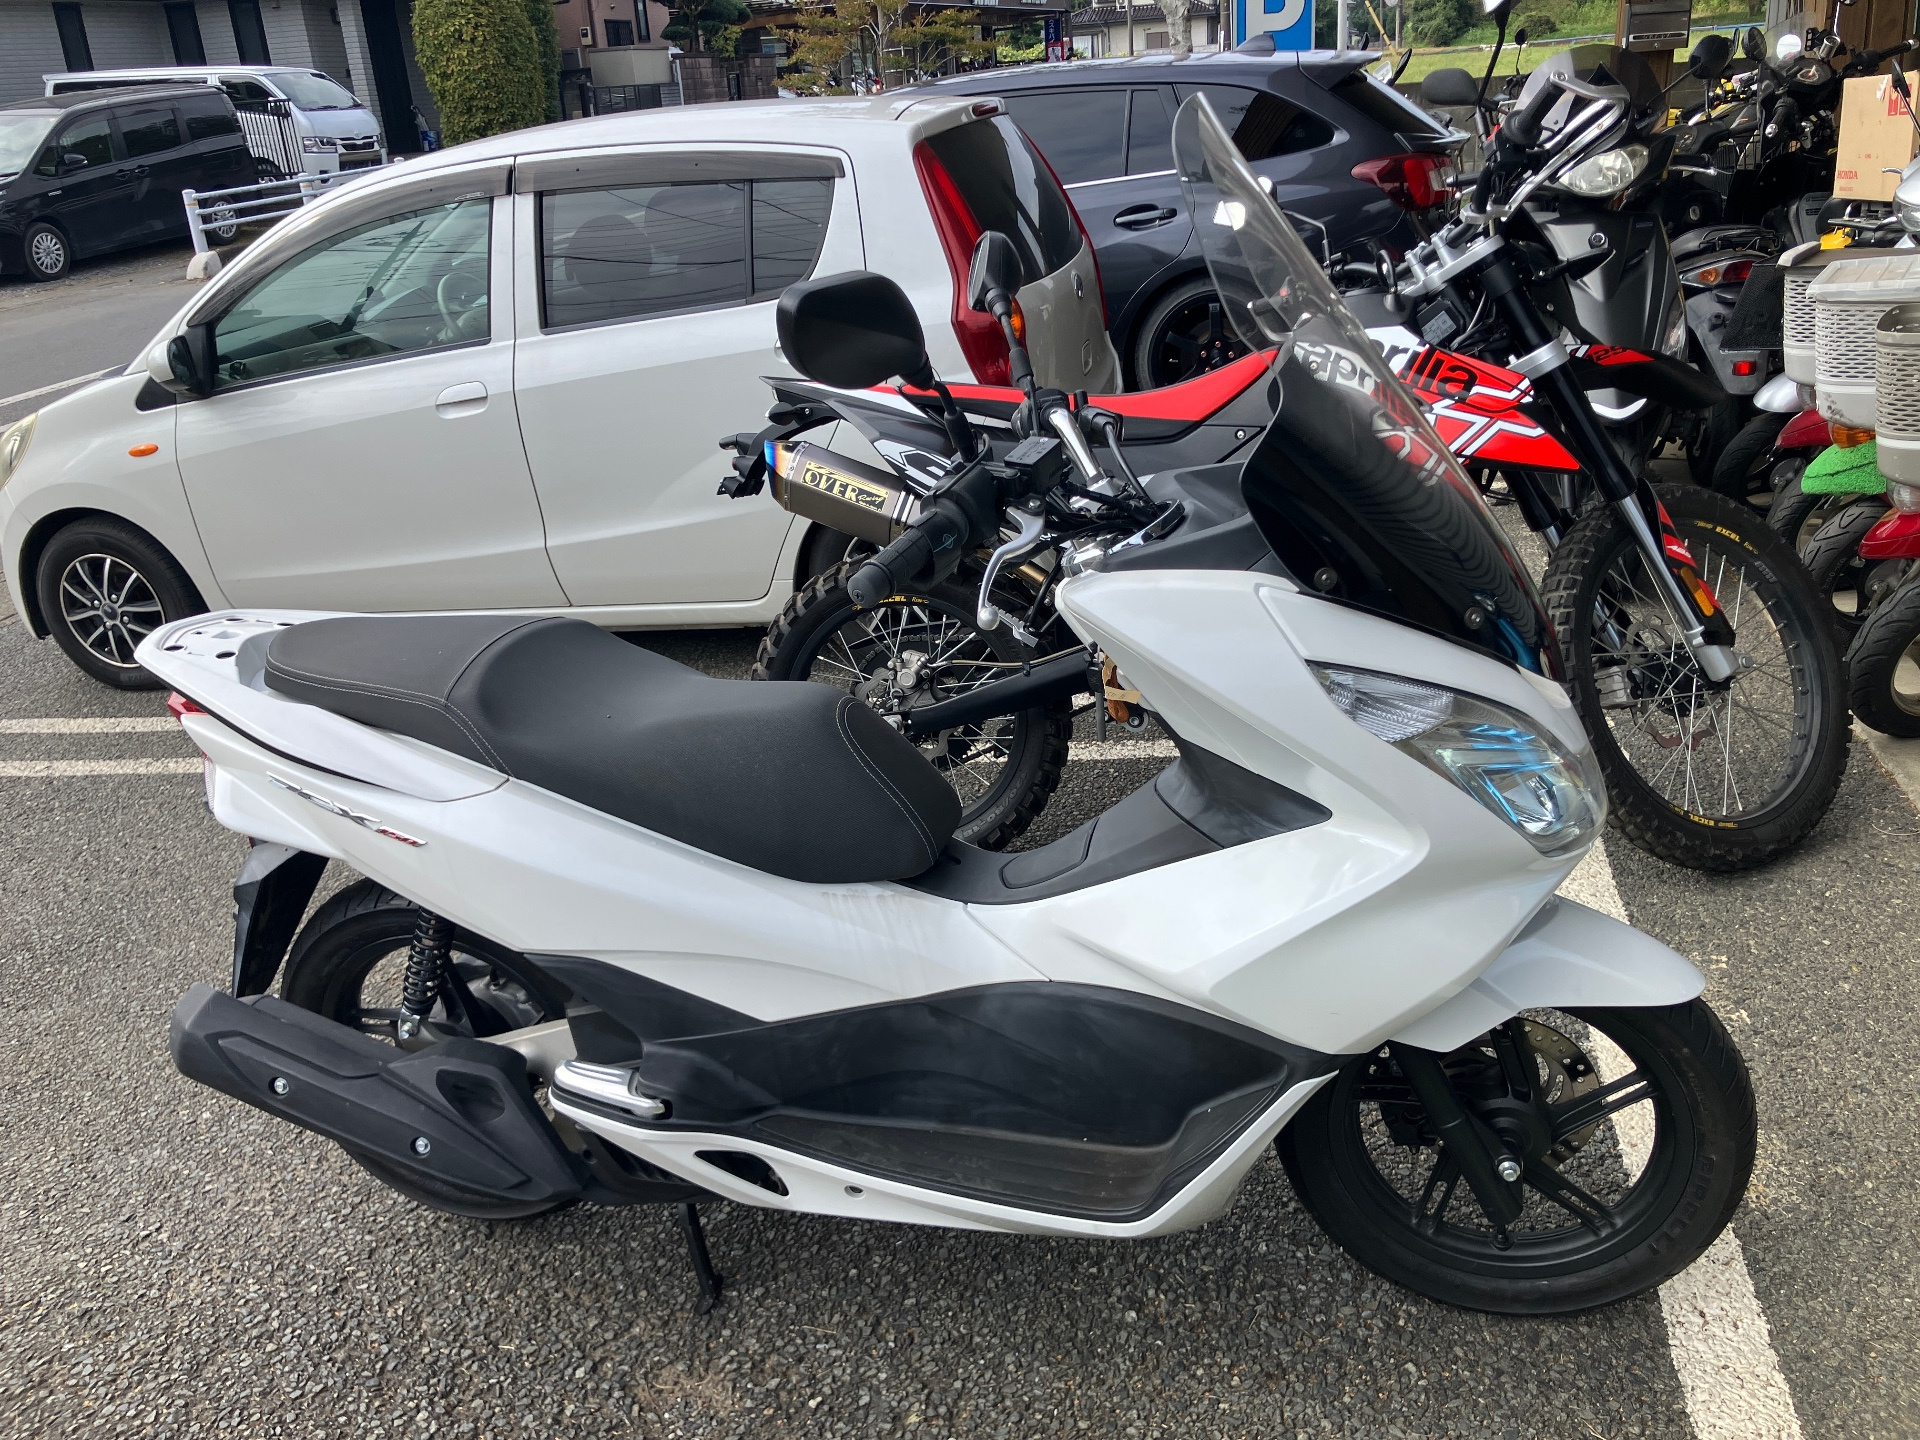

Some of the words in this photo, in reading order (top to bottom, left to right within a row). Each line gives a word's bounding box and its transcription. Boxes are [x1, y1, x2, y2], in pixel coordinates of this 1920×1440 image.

[1246, 0, 1305, 40] P
[1837, 170, 1858, 179] HONDA
[804, 470, 859, 502] OVER
[1715, 526, 1740, 542] EXCEL
